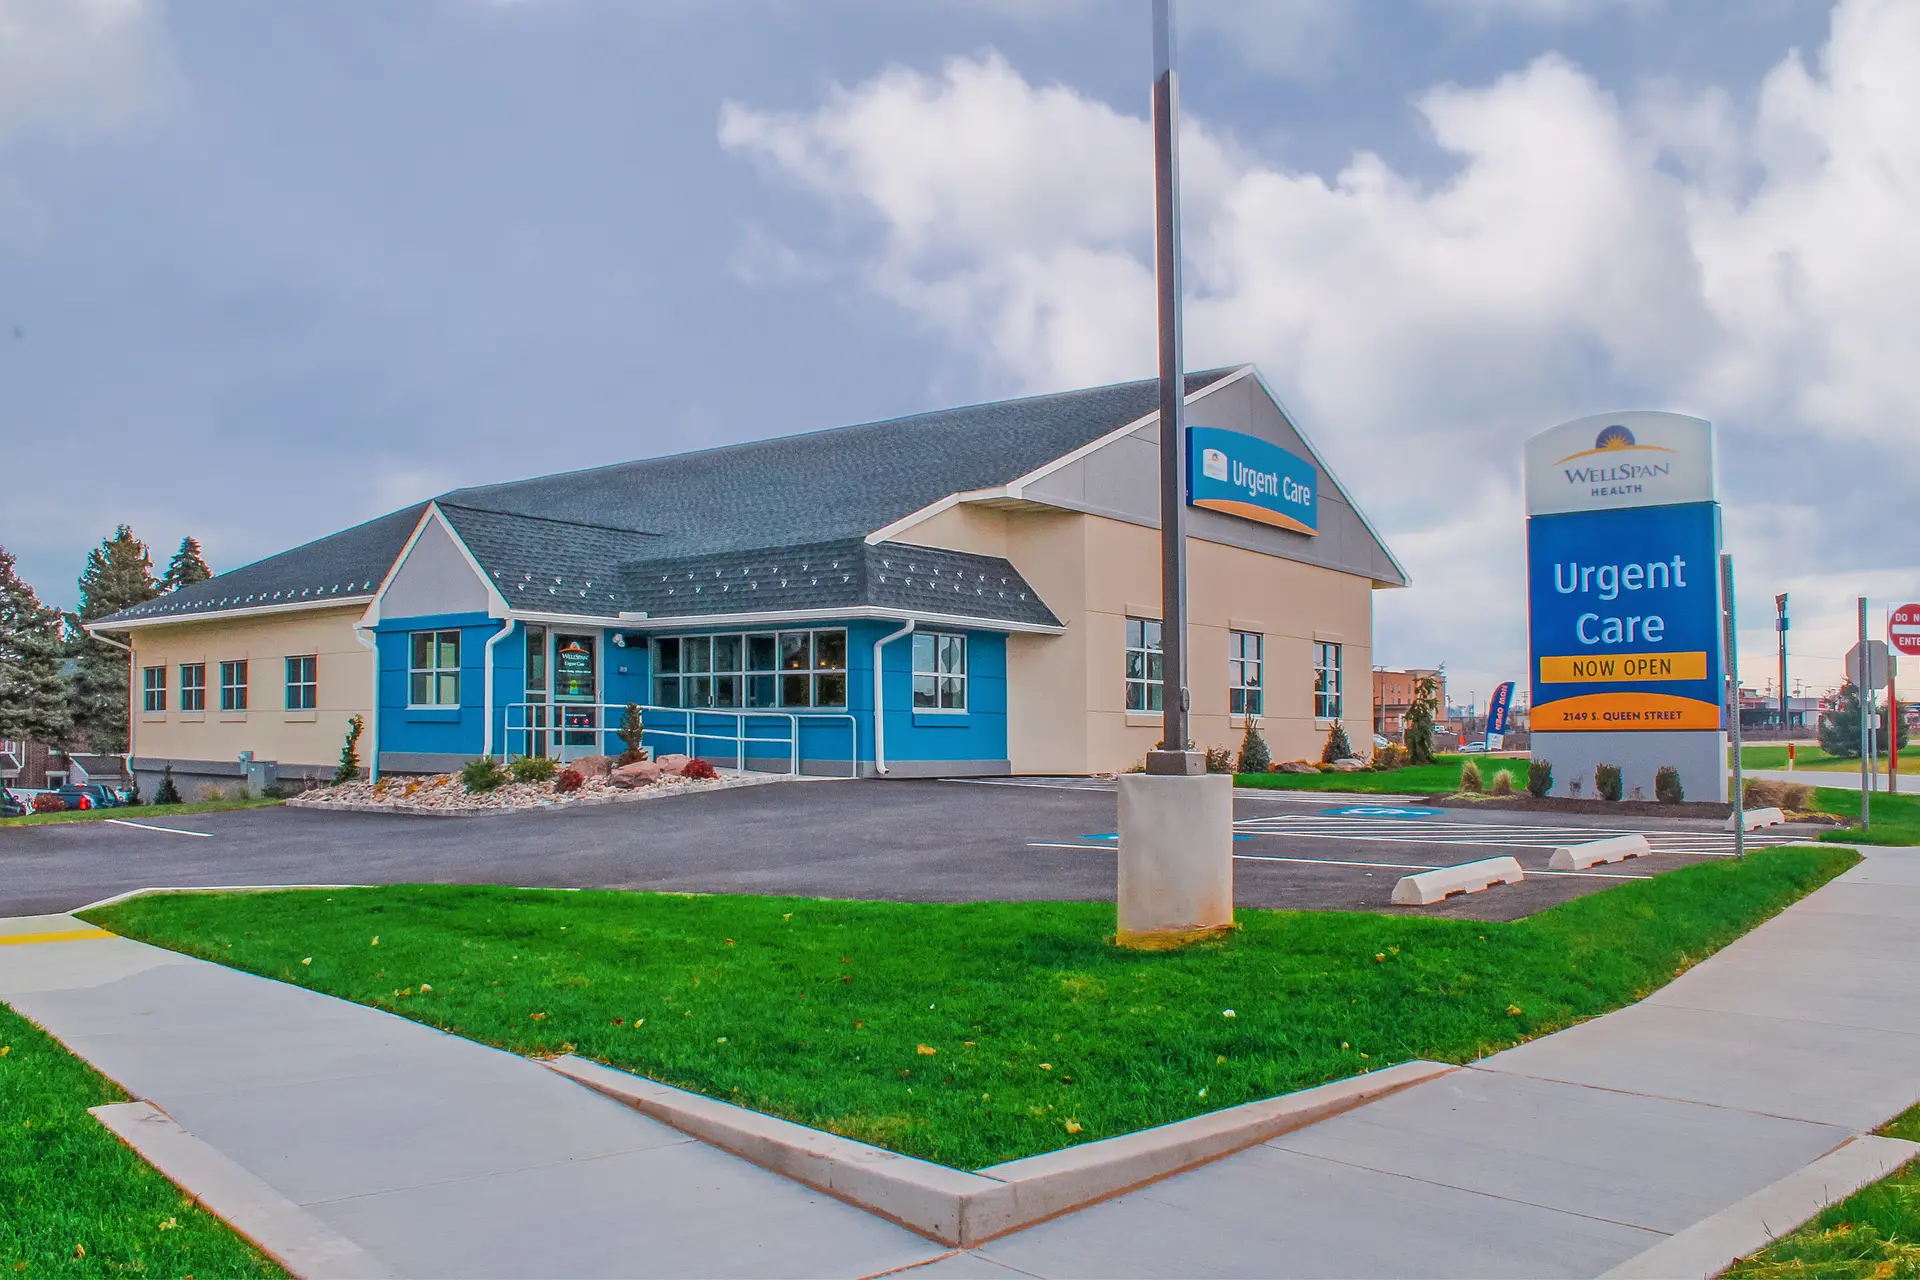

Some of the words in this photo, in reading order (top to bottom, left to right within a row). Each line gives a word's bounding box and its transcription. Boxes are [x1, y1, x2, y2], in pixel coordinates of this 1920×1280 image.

[1233, 460, 1278, 497] Urgent
[1283, 477, 1311, 506] Care
[1591, 485, 1642, 496] HEALTH
[1554, 555, 1686, 600] Urgent
[1895, 613, 1908, 622] DO
[1576, 613, 1665, 644] Care
[1899, 637, 1920, 646] ENTE
[1573, 660, 1614, 677] NOW
[1624, 659, 1671, 676] OPEN
[1499, 685, 1508, 705] NOW
[1495, 708, 1504, 730] OPEN
[1563, 712, 1588, 720] 2149
[1591, 712, 1600, 720] S.
[1603, 711, 1640, 721] QUEEN
[1644, 711, 1683, 720] STREET
